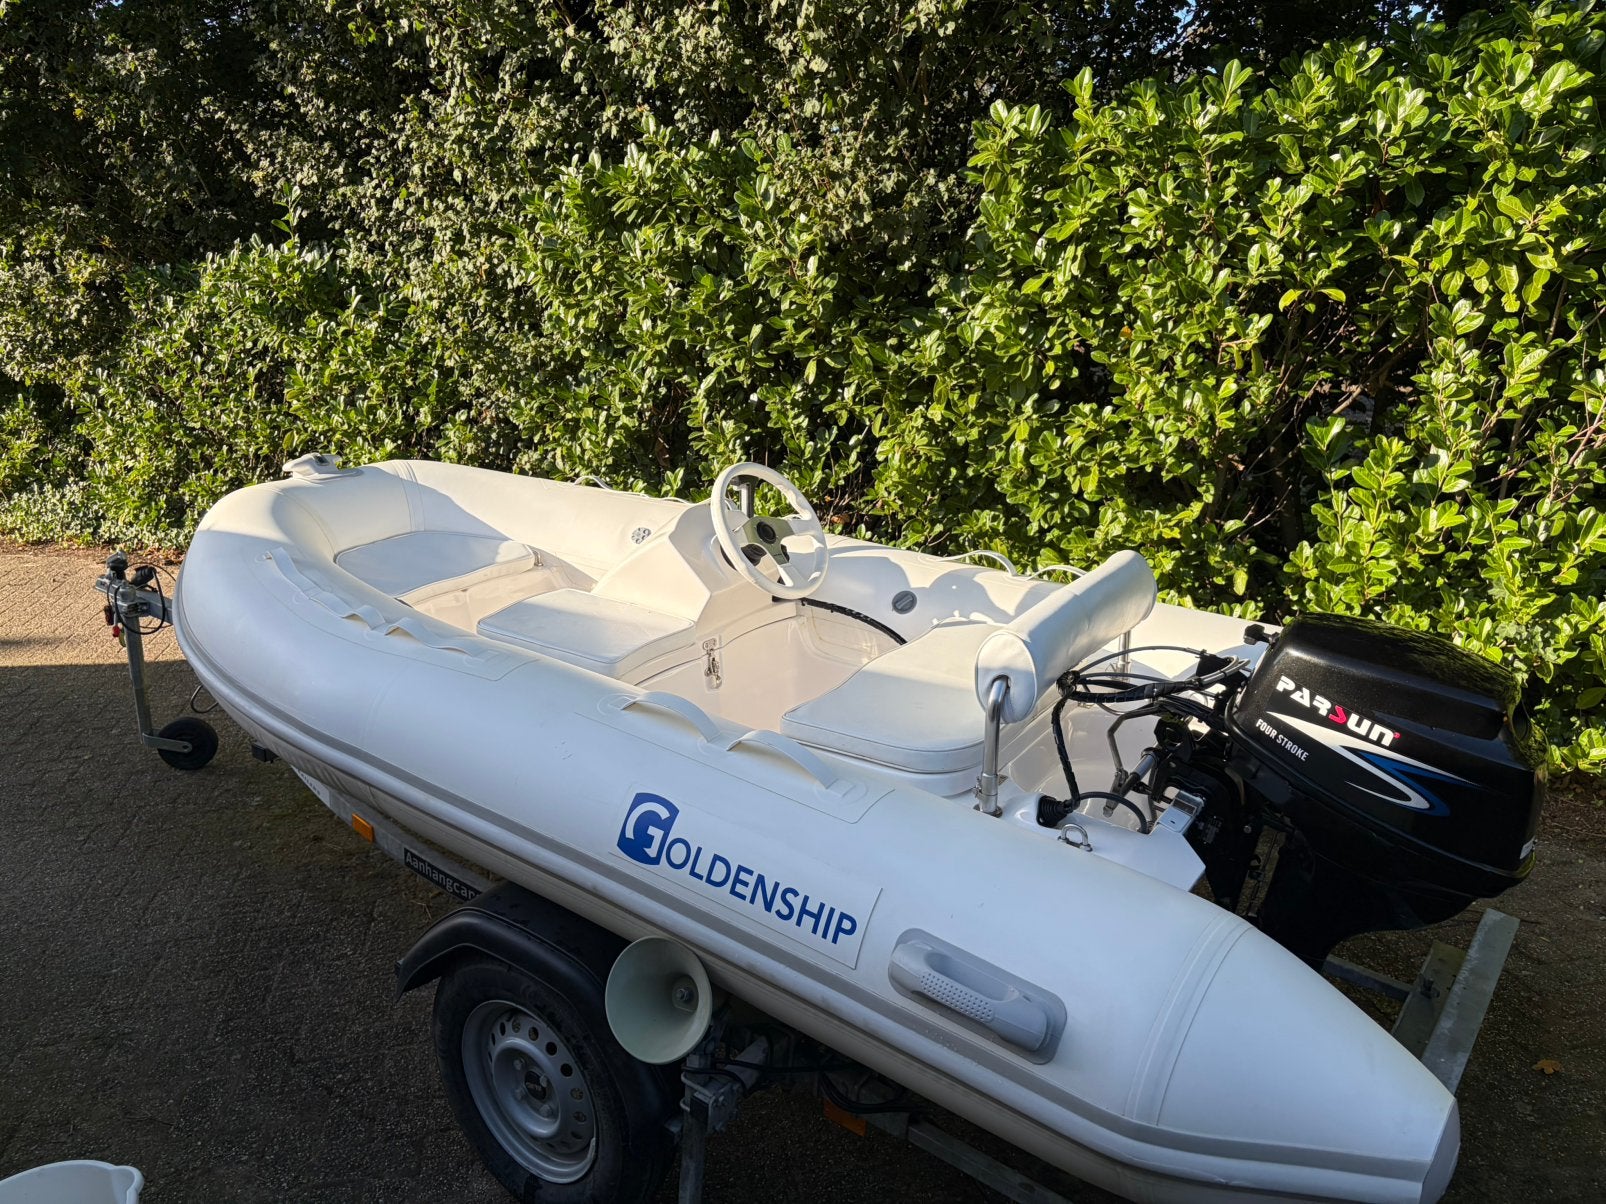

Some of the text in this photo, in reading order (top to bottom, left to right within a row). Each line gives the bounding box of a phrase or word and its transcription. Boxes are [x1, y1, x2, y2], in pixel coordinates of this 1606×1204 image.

[1255, 718, 1310, 762] FOUR STROKE
[1276, 675, 1395, 747] PARSUN
[617, 792, 858, 945] GOLDENSHIP
